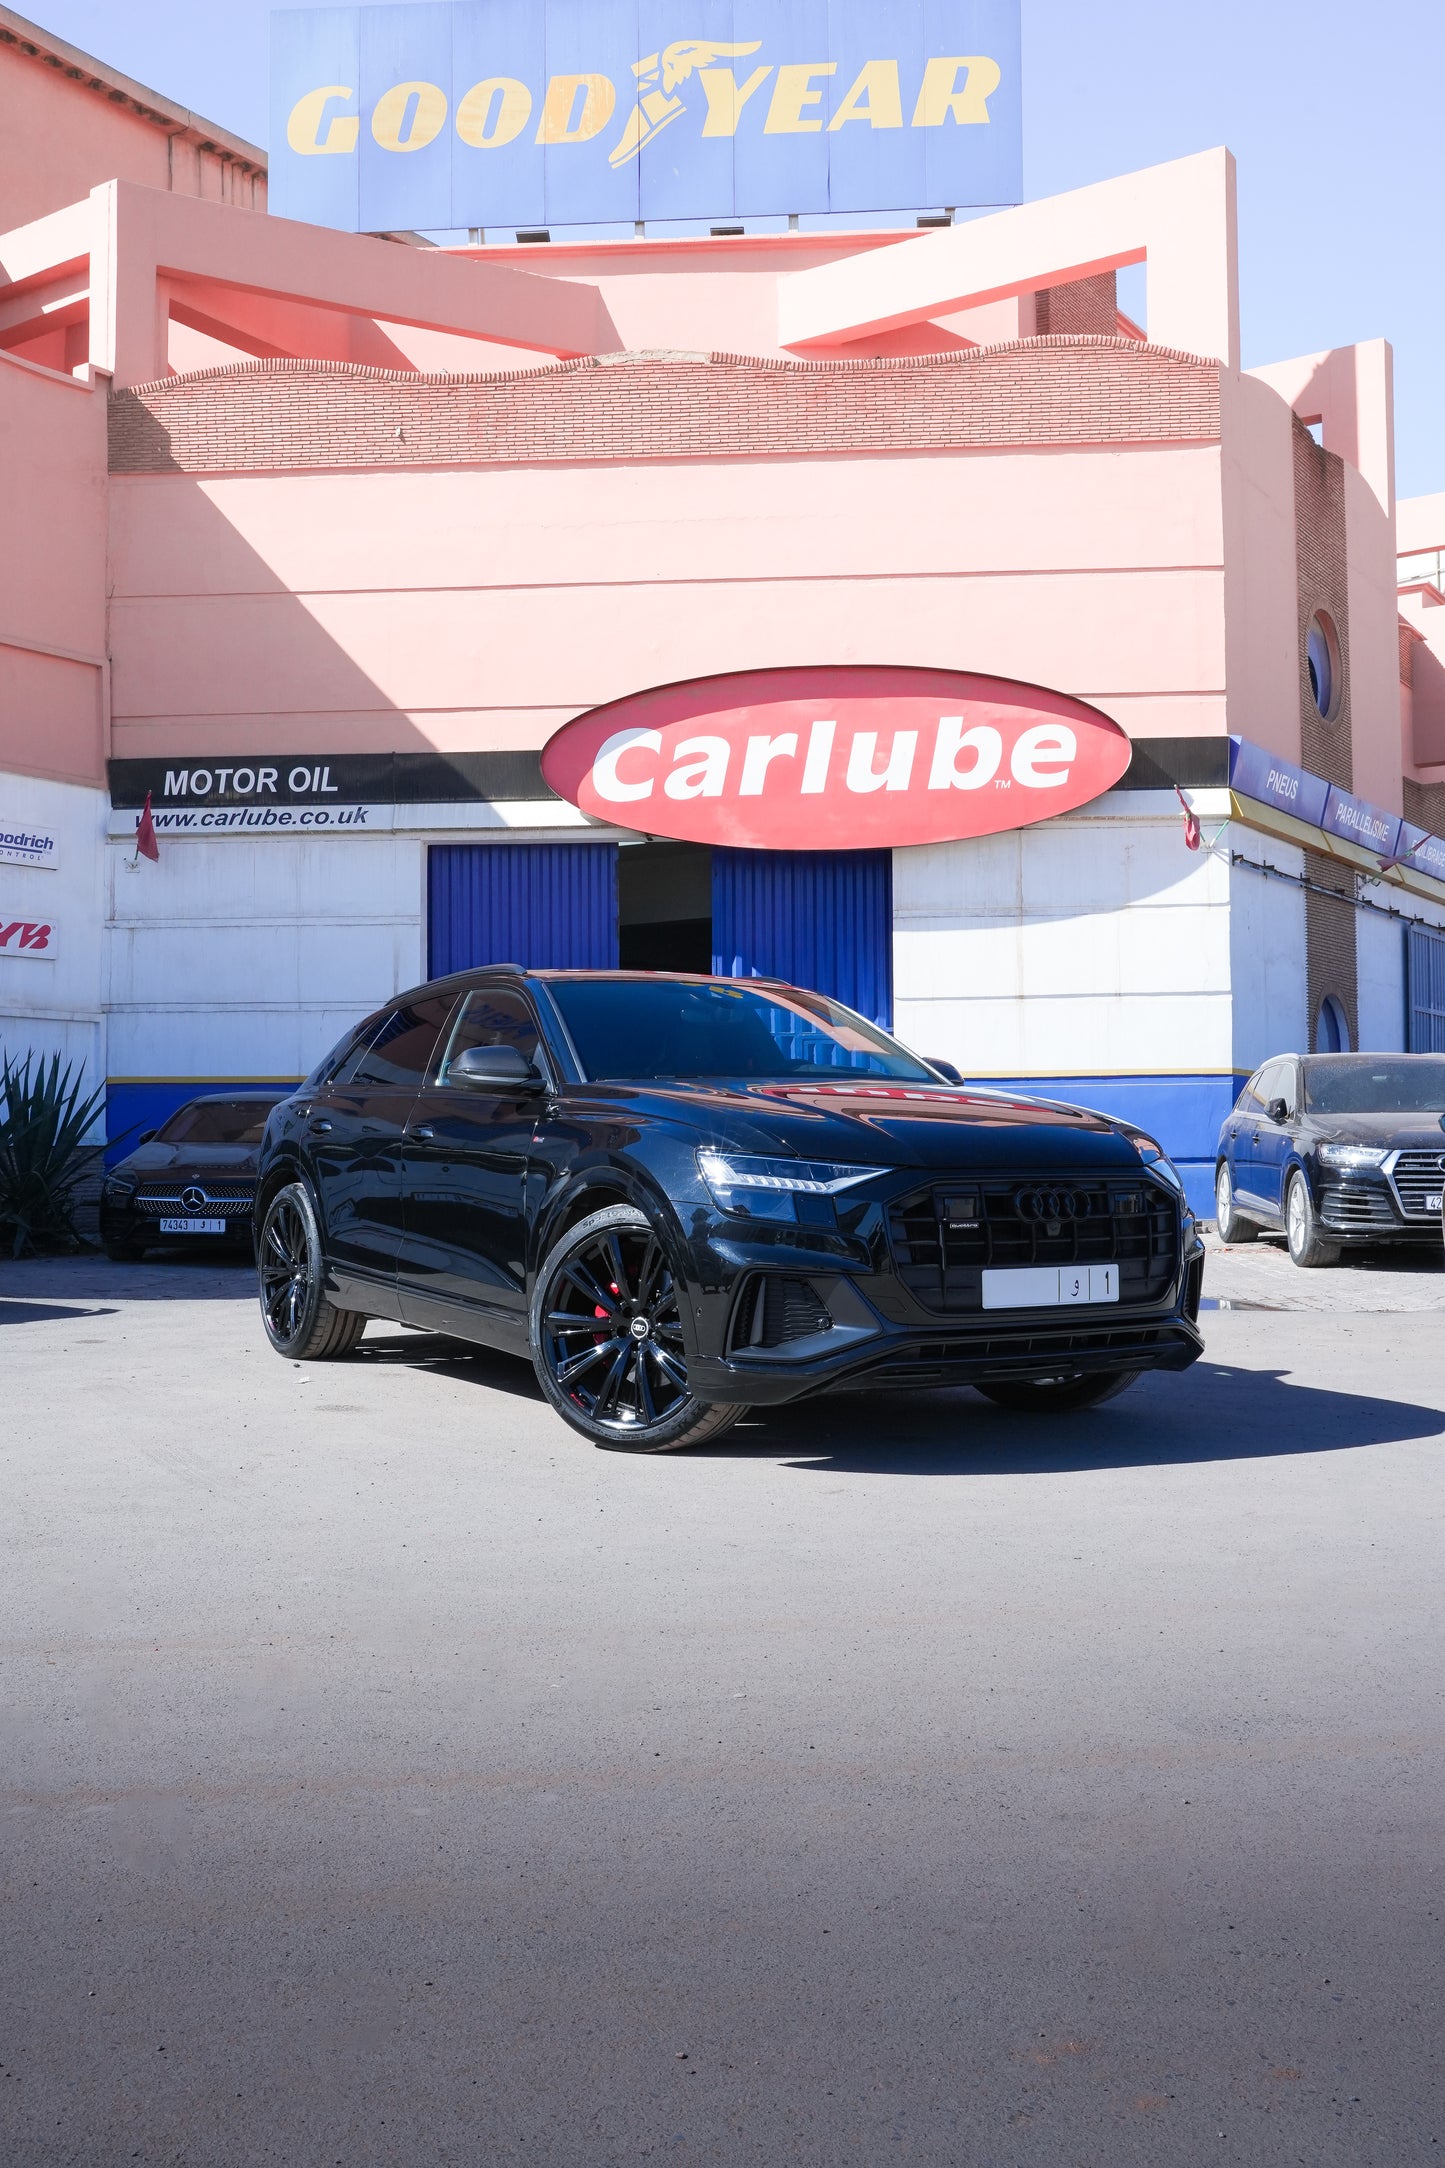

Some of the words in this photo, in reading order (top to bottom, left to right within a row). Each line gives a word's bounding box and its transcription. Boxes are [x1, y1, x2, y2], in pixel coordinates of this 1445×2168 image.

[592, 716, 1078, 803] Carlube
[164, 767, 278, 796] MOTOR
[288, 766, 338, 793] OIL
[1266, 769, 1299, 799] PNEUS
[1335, 803, 1390, 842] PARALLELISME
[162, 1219, 188, 1231] 74343
